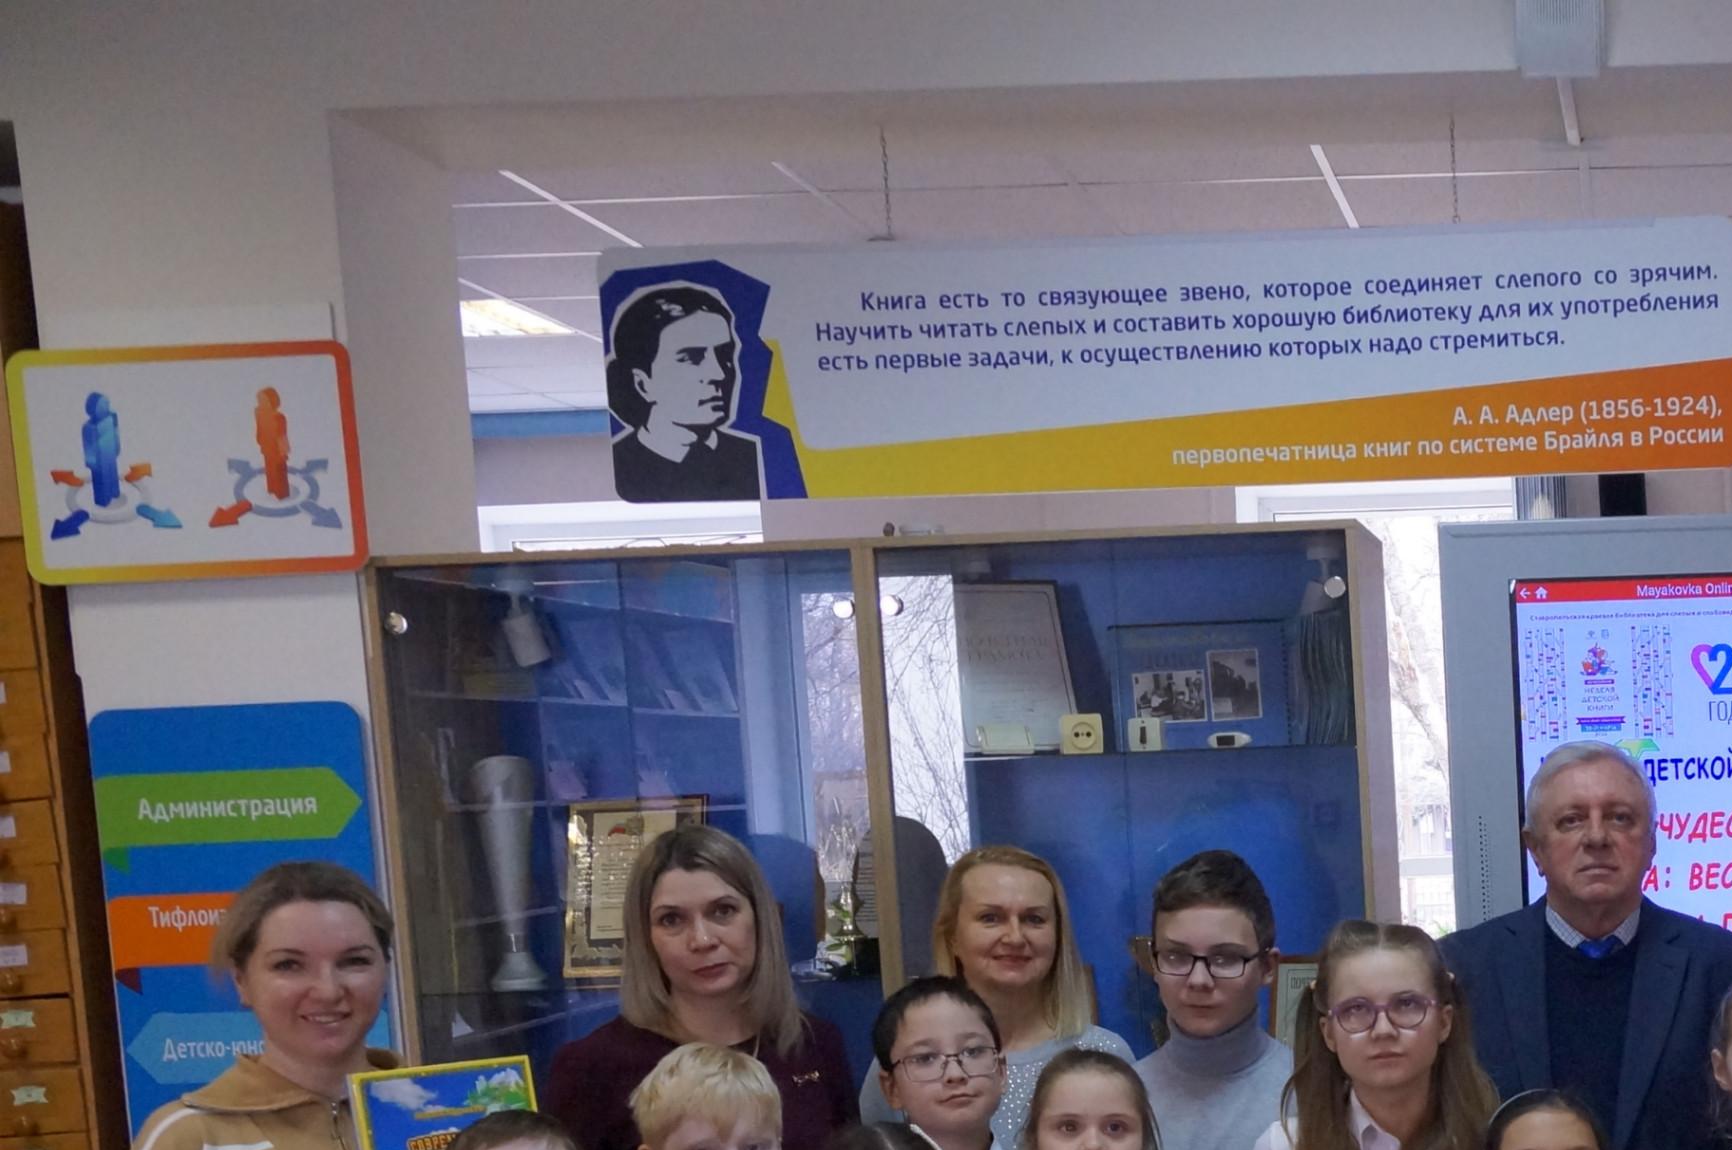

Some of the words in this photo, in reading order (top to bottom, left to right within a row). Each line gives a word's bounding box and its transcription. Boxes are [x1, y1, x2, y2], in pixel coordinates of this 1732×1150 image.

[860, 290, 927, 313] Книга
[939, 290, 989, 309] есть
[1001, 290, 1026, 307] то
[1038, 286, 1167, 311] связующее
[1180, 283, 1250, 303] звено,
[1263, 278, 1352, 299] которое
[1364, 273, 1483, 296] соединяет
[1495, 269, 1582, 291] слепого
[1594, 269, 1617, 285] со
[1630, 263, 1718, 286] зрячим.
[816, 322, 913, 347] Научить
[919, 319, 997, 340] читать
[1004, 317, 1087, 338] слепых
[1094, 316, 1108, 334] и
[1113, 310, 1226, 335] составить
[1232, 306, 1337, 332] хорошую
[1343, 299, 1471, 326] библиотеку
[1479, 302, 1521, 323] для
[1528, 300, 1553, 318] их
[1561, 291, 1720, 319] употребления
[818, 352, 869, 371] есть
[875, 350, 963, 373] первые
[968, 347, 1055, 371] задачи,
[1062, 347, 1074, 363] к
[1081, 340, 1262, 367] осуществлению
[1269, 333, 1363, 358] которых
[1369, 332, 1423, 354] надо
[1429, 327, 1566, 352] стремиться.
[1453, 405, 1473, 426] А.
[1479, 404, 1499, 425] А.
[1505, 402, 1574, 426] Адлер
[1580, 394, 1723, 424] (1856-1924),
[1172, 438, 1357, 469] первопечатница
[1363, 438, 1412, 459] книг
[1418, 438, 1444, 456] по
[1449, 434, 1538, 456] системе
[1544, 427, 1624, 451] Брайля
[1631, 430, 1643, 447] в
[1650, 425, 1724, 447] России
[1636, 583, 1702, 597] Mayakovka
[138, 795, 318, 823] Администрация
